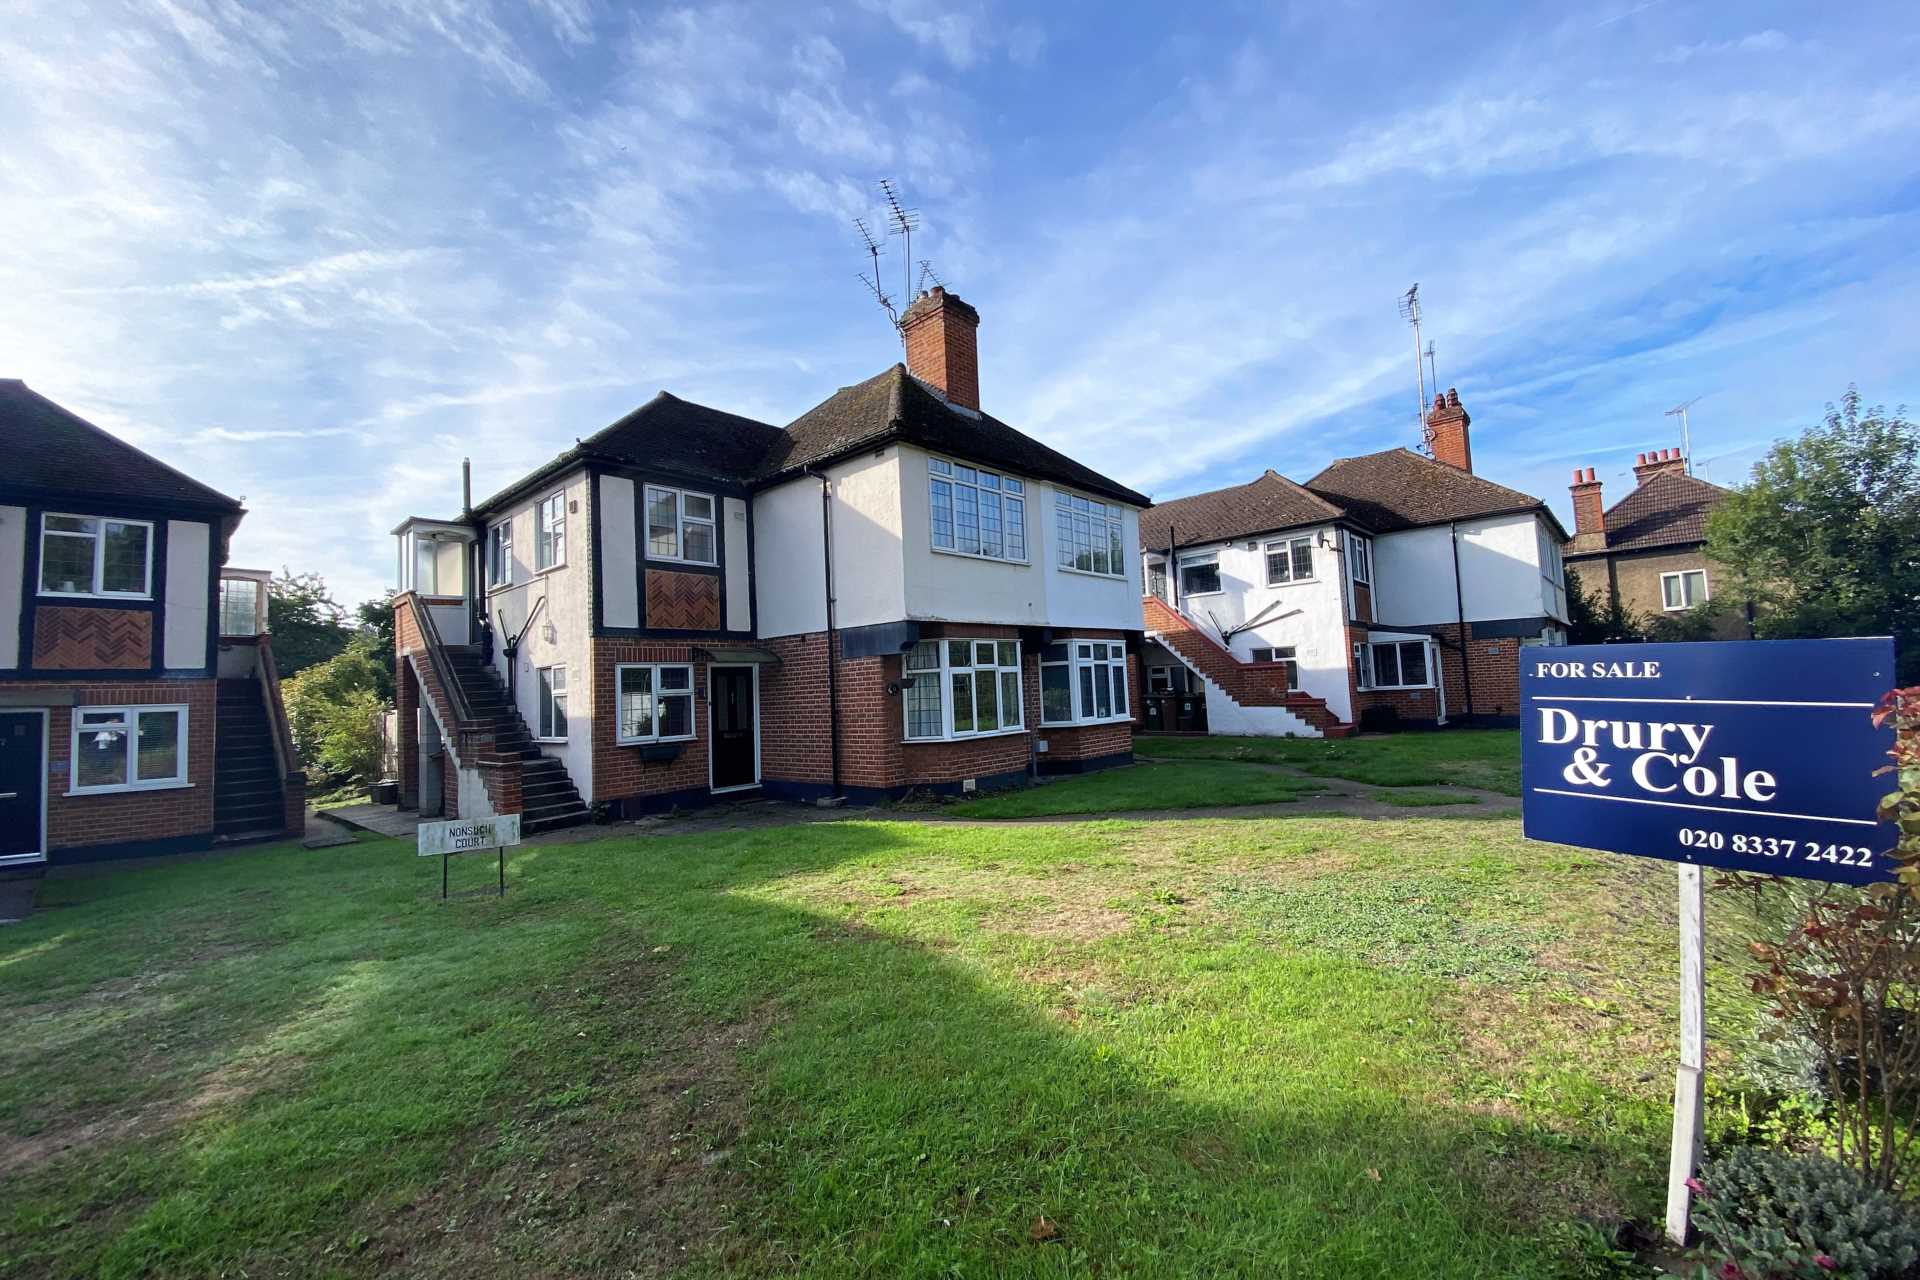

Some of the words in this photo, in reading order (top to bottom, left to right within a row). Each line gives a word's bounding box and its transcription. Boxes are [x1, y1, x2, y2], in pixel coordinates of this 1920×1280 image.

[1535, 662, 1587, 679] FOR
[1592, 661, 1661, 679] SALE
[1537, 707, 1715, 765] Drury
[1563, 747, 1611, 788] &
[1632, 752, 1777, 802] Cole
[455, 836, 485, 849] COURT
[1678, 828, 1723, 850] 020
[1732, 834, 1796, 859] 8337
[1805, 842, 1873, 868] 2422
